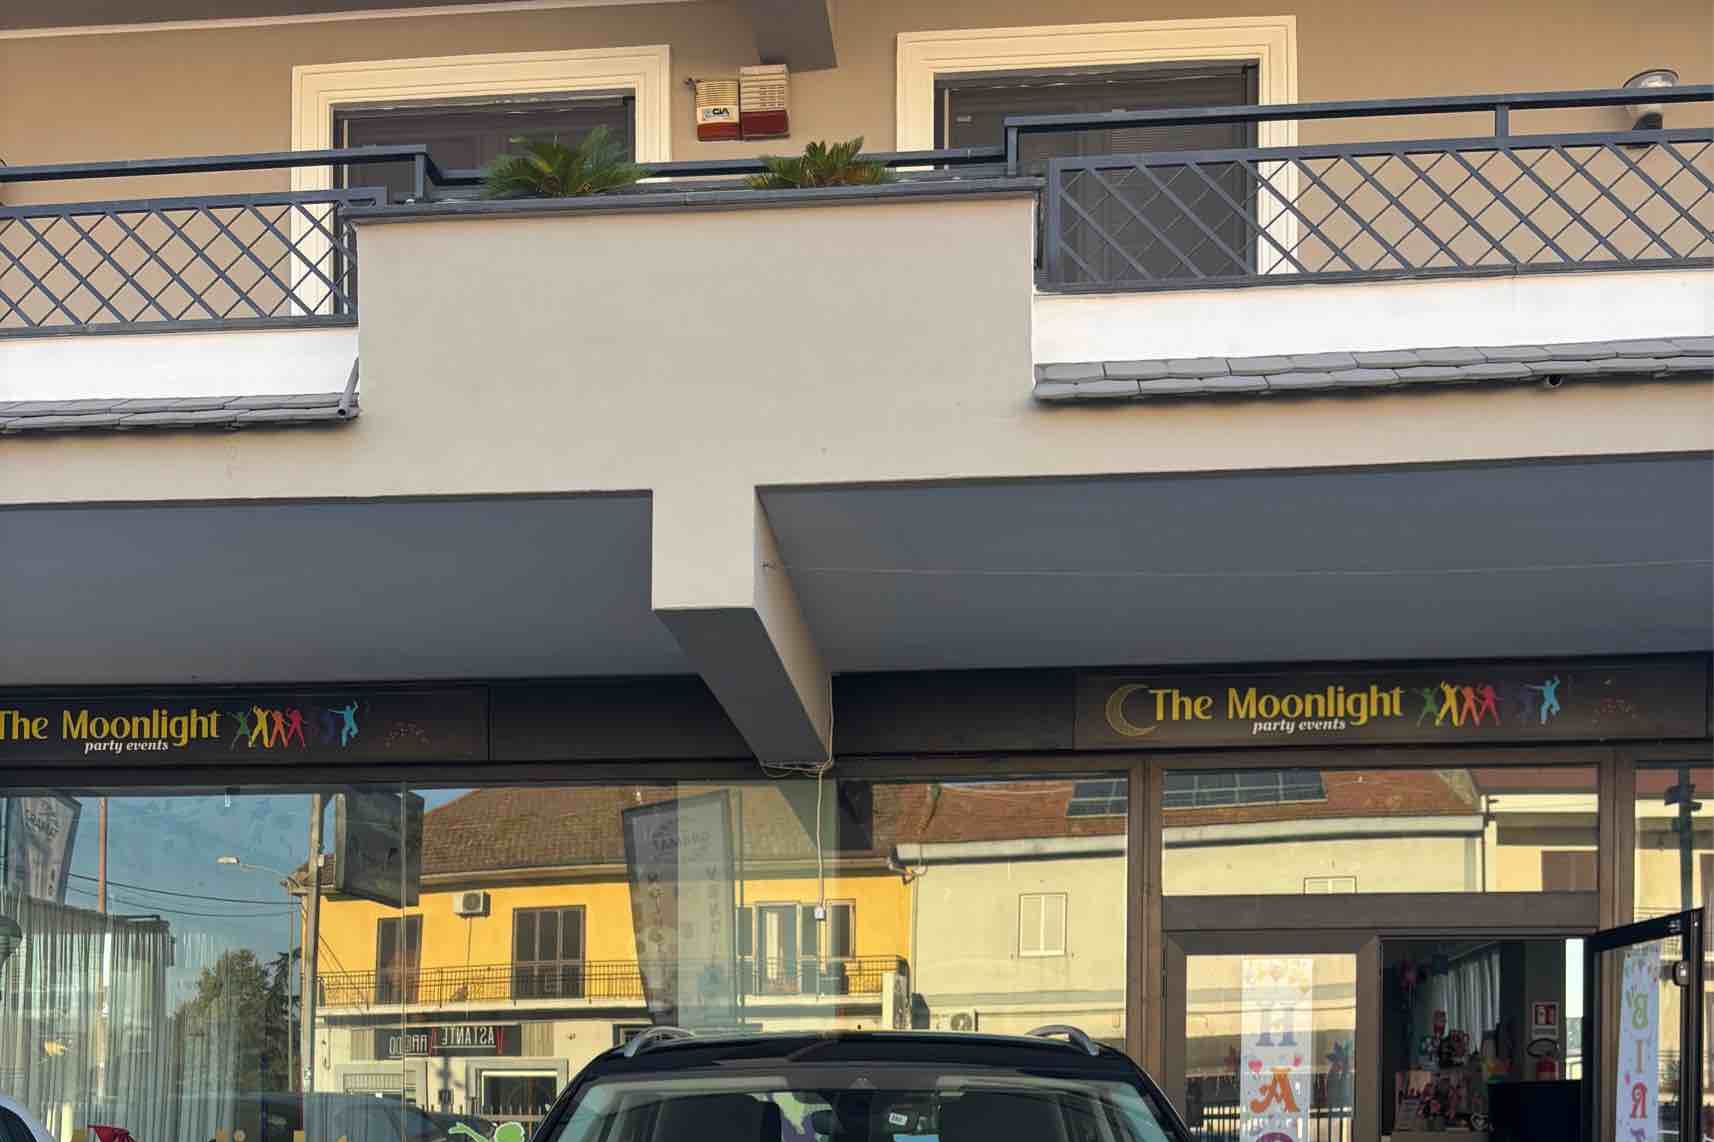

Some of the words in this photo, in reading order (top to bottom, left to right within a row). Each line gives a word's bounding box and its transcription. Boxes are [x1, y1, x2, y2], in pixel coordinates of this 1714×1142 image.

[1148, 688, 1213, 721] The
[1227, 685, 1405, 725] Moonlight
[62, 708, 222, 747] Moonlight
[1252, 719, 1295, 735] party
[1298, 717, 1346, 731] events
[84, 739, 123, 754] party
[126, 739, 169, 751] events
